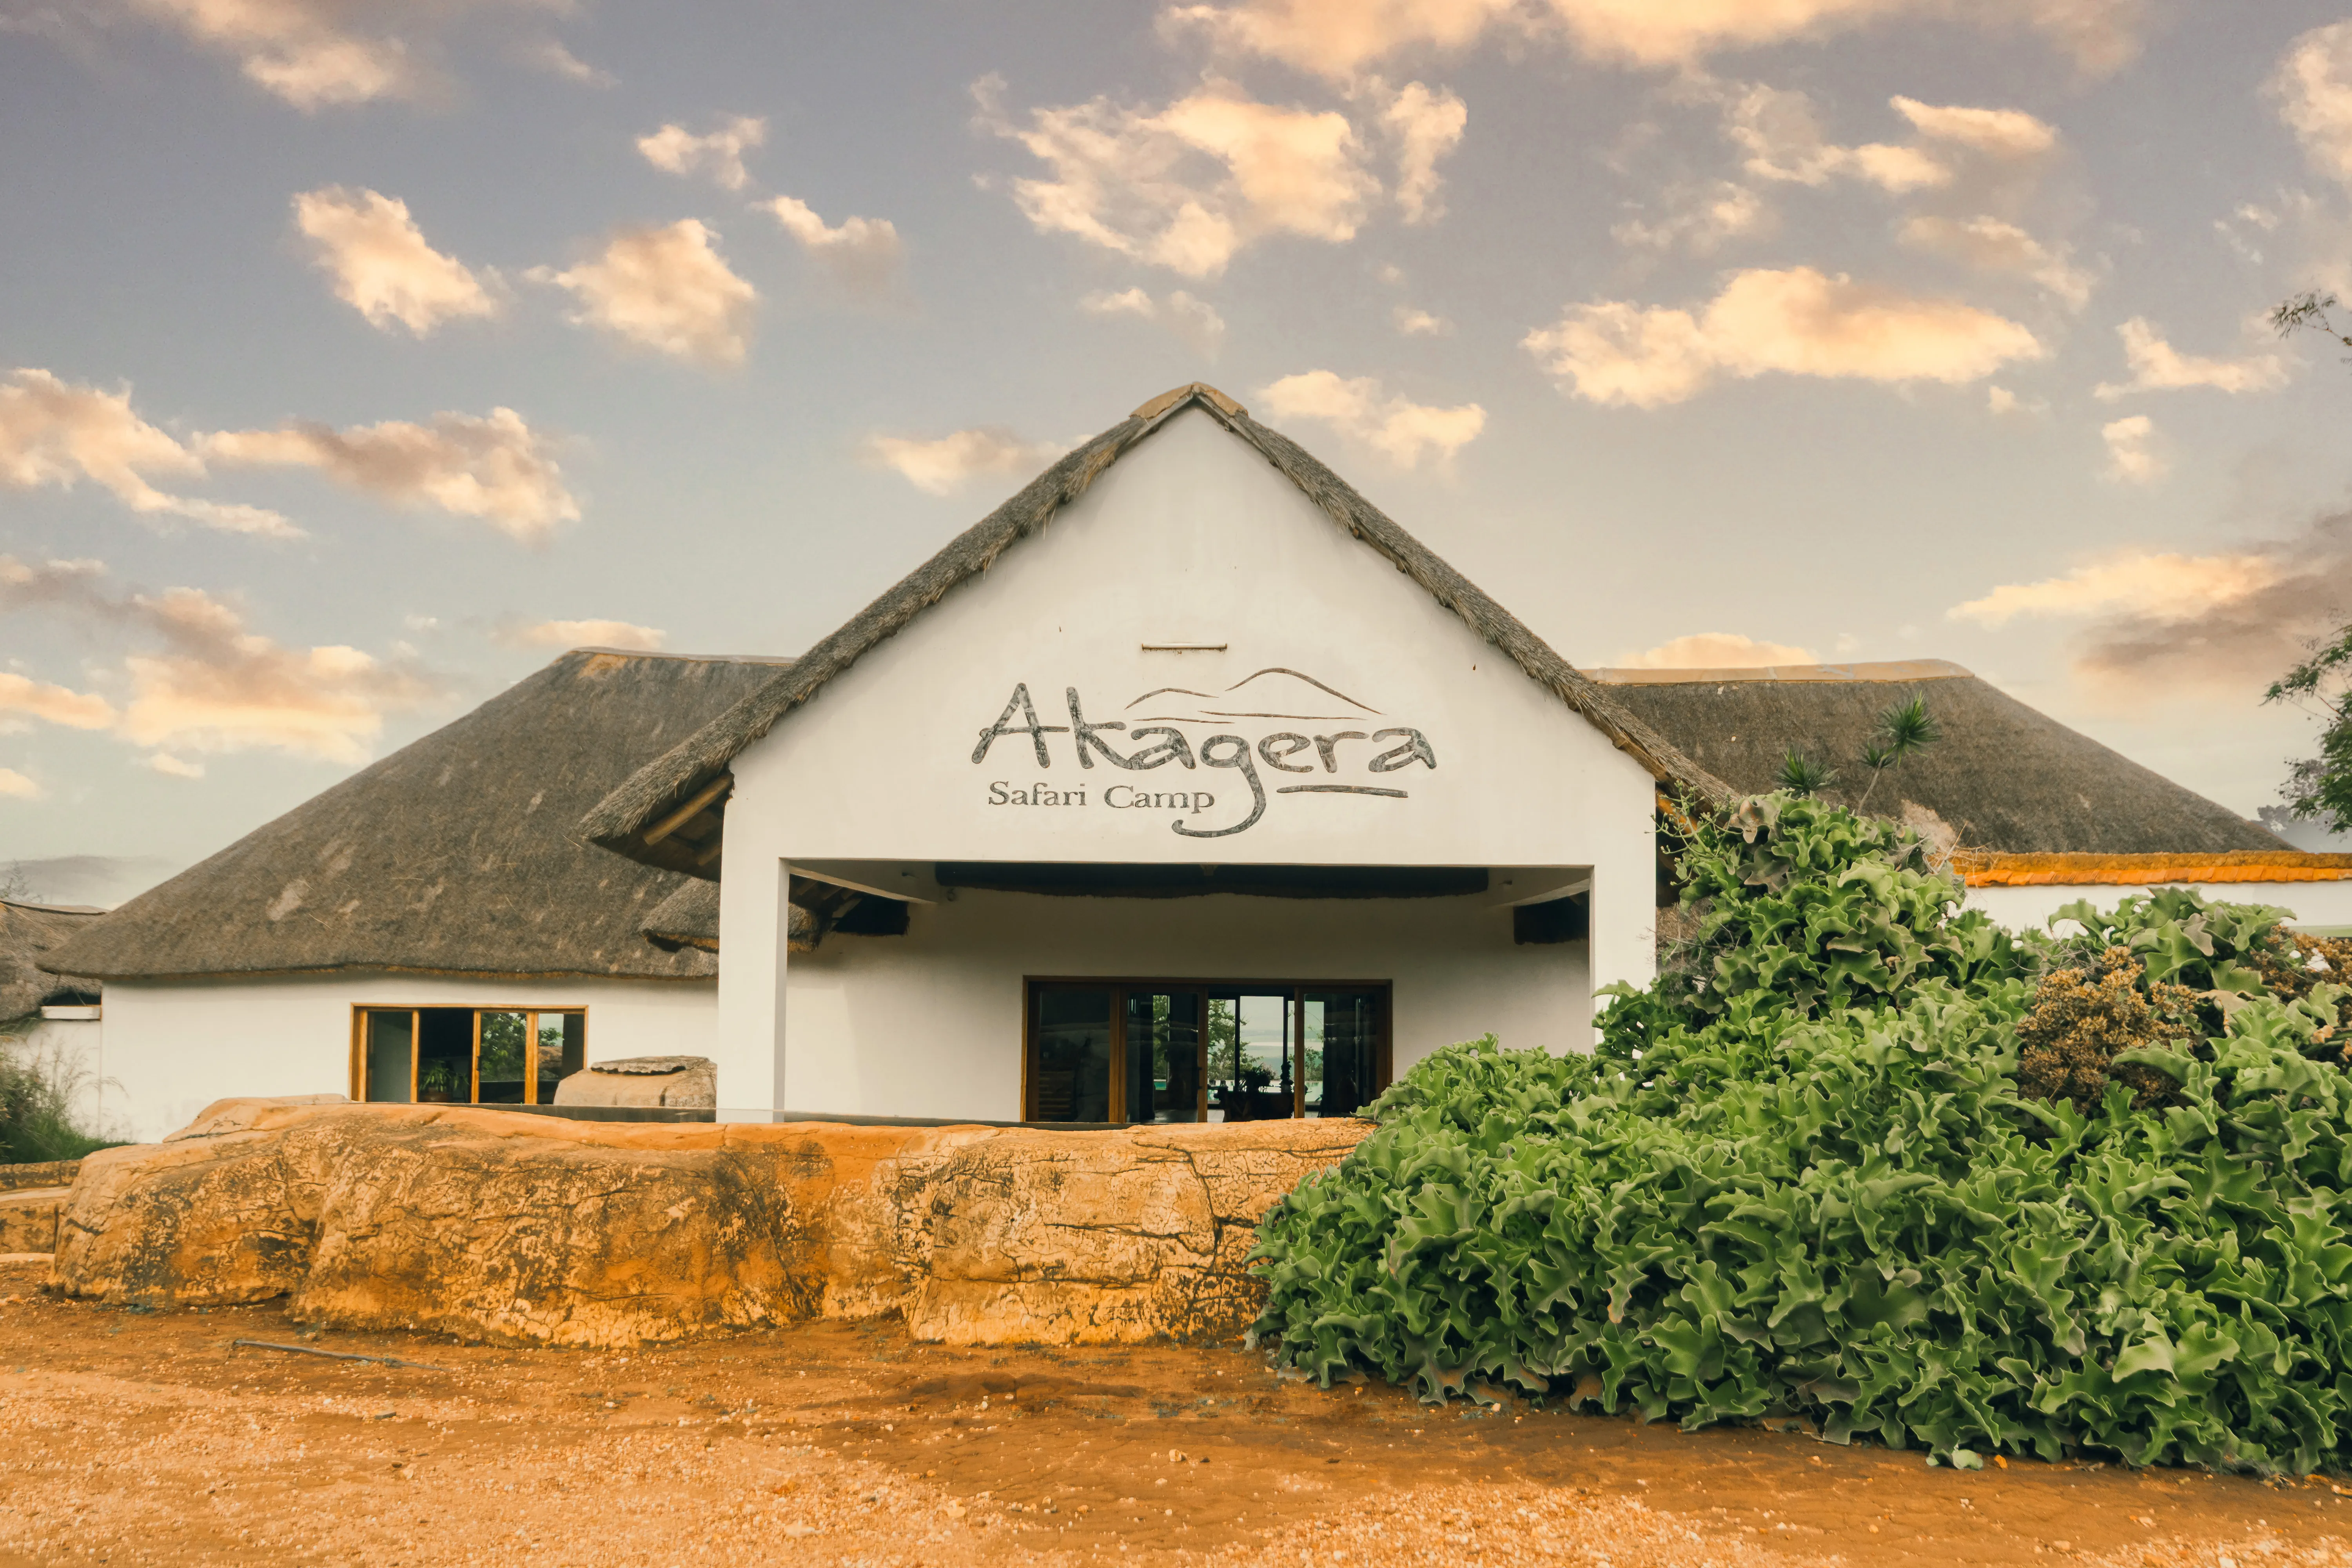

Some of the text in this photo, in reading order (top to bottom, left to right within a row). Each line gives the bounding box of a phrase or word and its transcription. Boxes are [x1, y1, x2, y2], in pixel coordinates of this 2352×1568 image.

[971, 682, 1437, 838] Akagera
[988, 781, 1215, 814] Safari Camp
